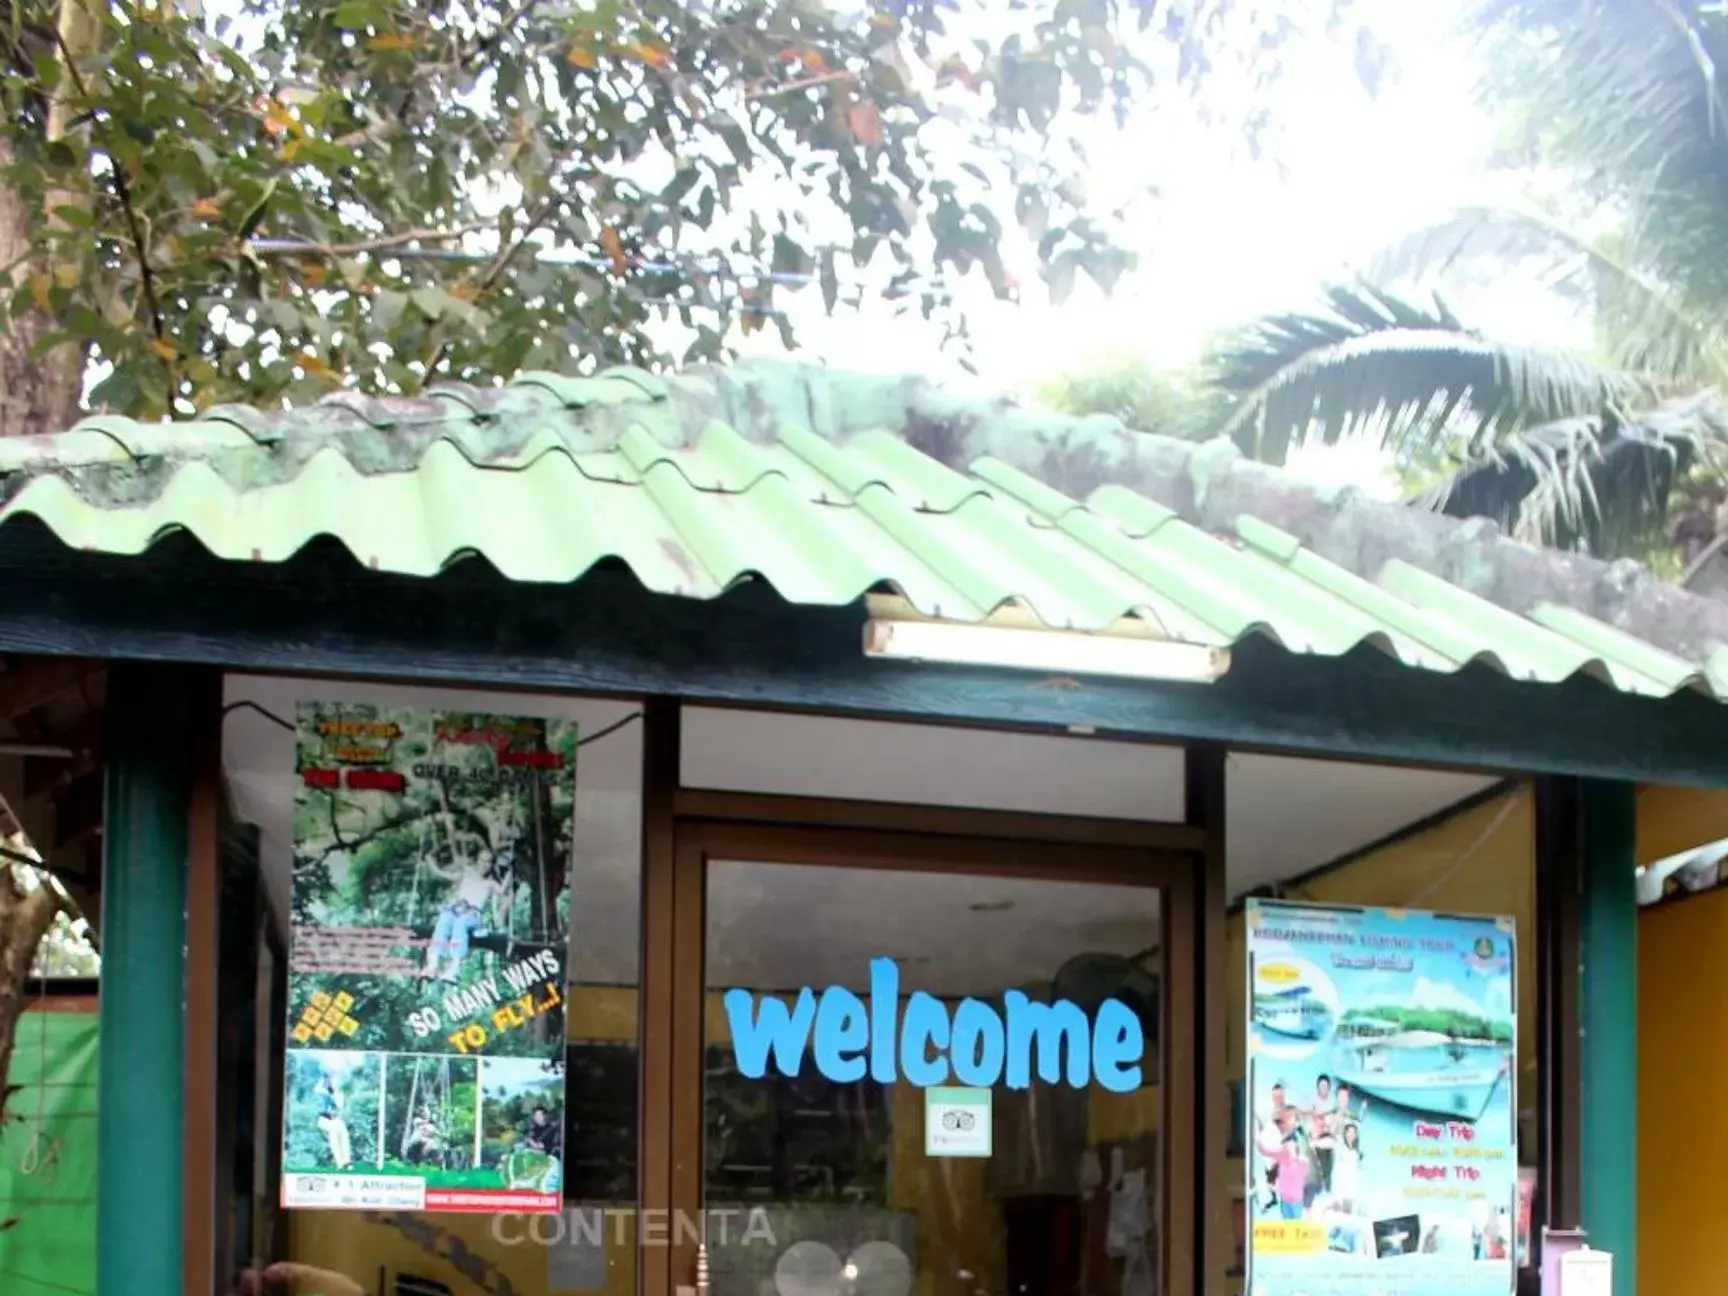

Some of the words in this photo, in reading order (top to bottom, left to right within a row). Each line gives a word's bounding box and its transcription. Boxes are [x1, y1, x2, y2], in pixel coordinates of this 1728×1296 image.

[409, 1007, 442, 1038] SO
[444, 974, 502, 1022] MANY
[503, 949, 560, 991] WAYS
[448, 1023, 487, 1053] TO
[723, 956, 1144, 1093] welcome
